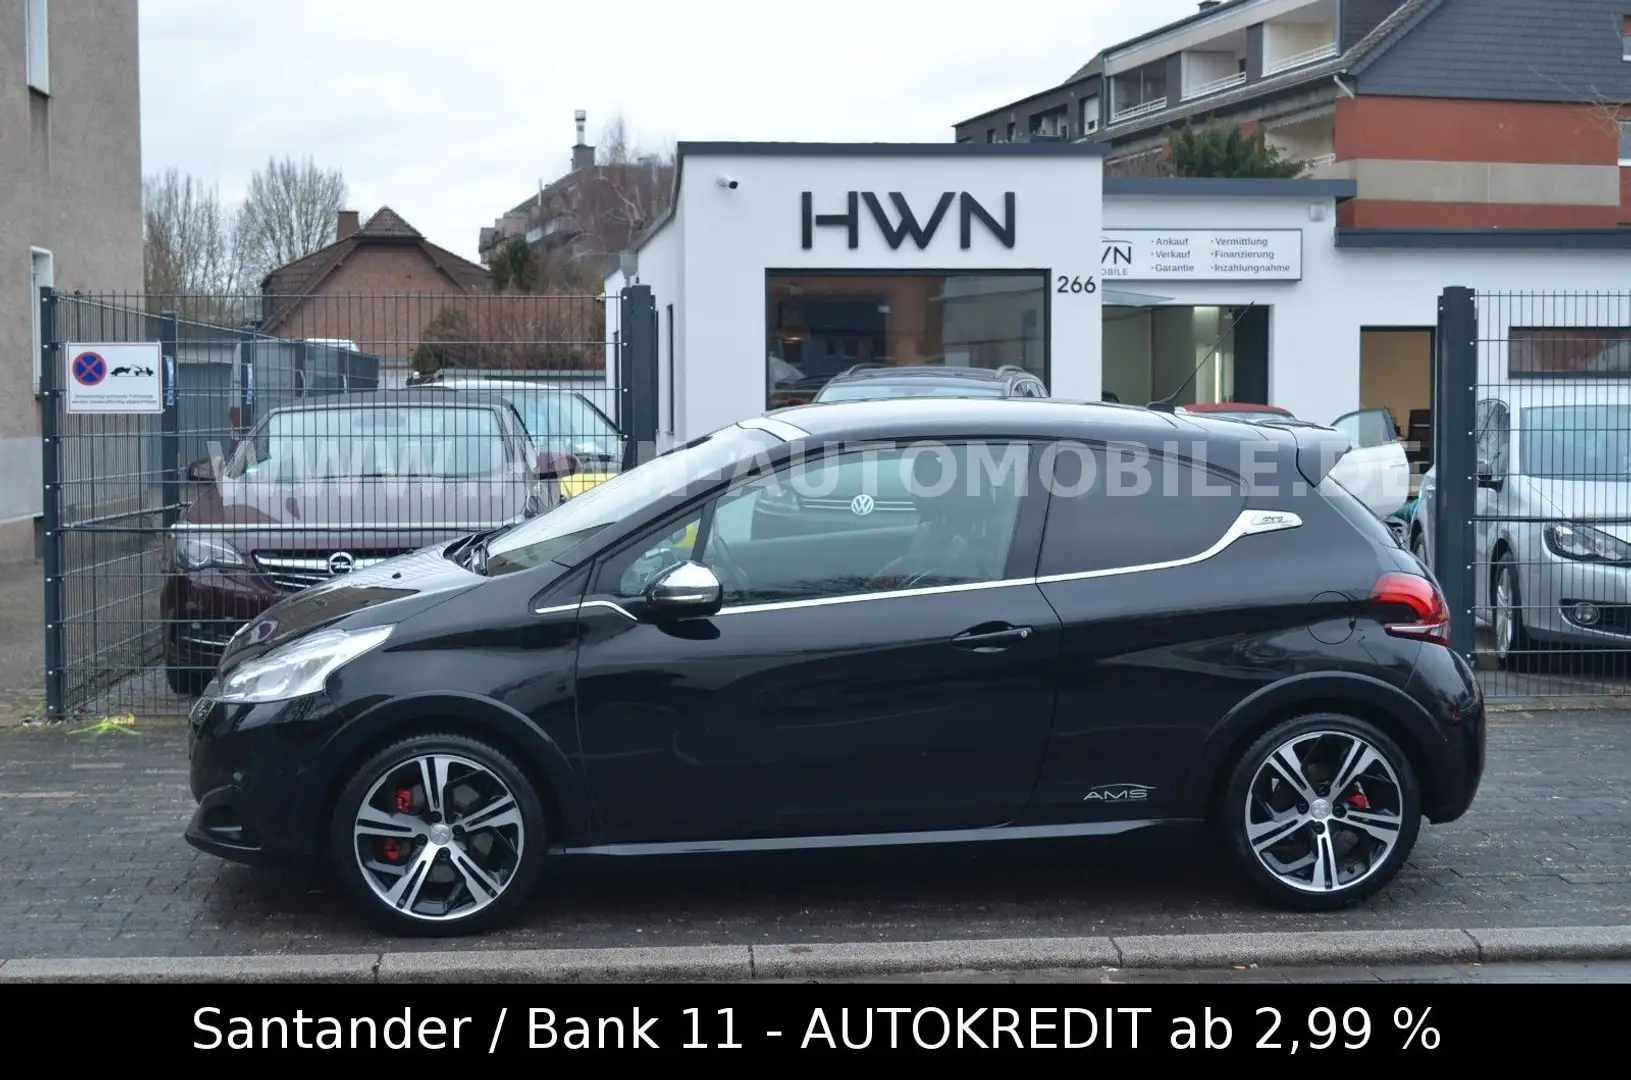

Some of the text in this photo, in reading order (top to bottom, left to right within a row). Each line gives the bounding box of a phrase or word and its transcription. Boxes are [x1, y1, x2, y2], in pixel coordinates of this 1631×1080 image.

[802, 191, 1015, 250] HWN
[1156, 237, 1188, 246] Ankauf
[1215, 237, 1269, 248] Vermittlung
[1156, 250, 1191, 259] Verkauf
[1214, 250, 1275, 260] Finanzierung
[1155, 263, 1195, 272] Garantie
[1214, 263, 1291, 274] Inzahlungnahme
[1057, 275, 1096, 294] 266
[1083, 789, 1148, 800] AMS
